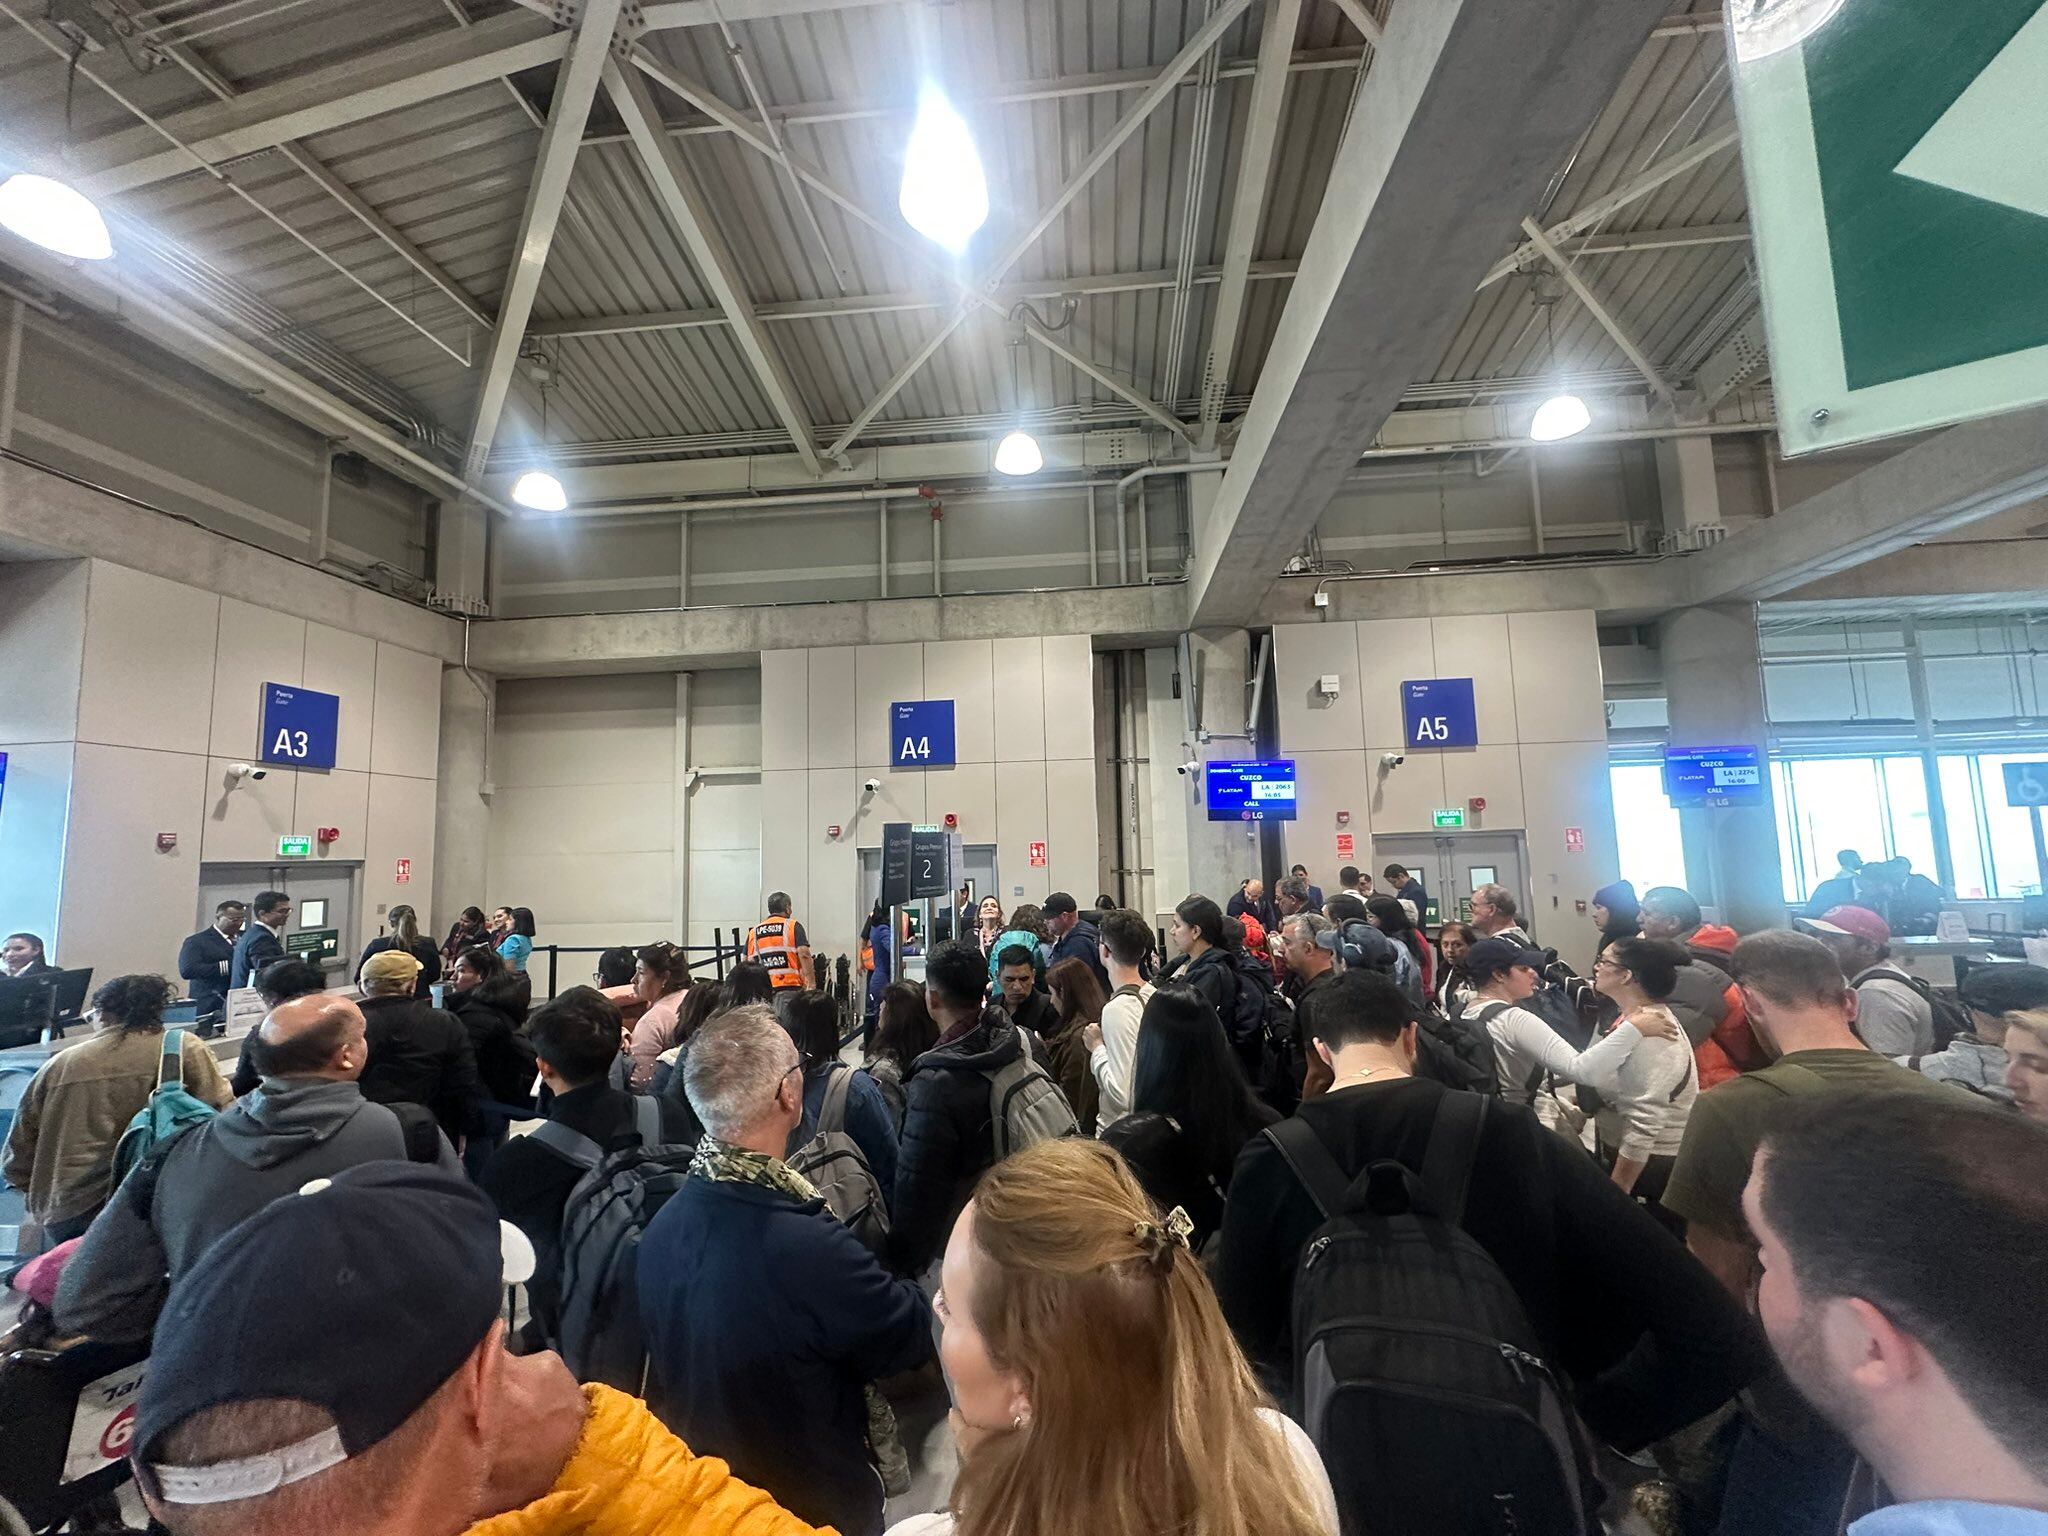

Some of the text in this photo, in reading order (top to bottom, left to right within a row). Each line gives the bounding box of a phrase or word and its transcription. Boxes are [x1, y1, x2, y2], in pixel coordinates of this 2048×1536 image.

[1416, 716, 1449, 741] A5
[272, 728, 308, 758] A3
[900, 736, 931, 760] A4
[1716, 798, 1729, 806] LG
[1252, 812, 1264, 820] LG
[283, 837, 308, 845] SALIDA
[923, 859, 932, 878] 2
